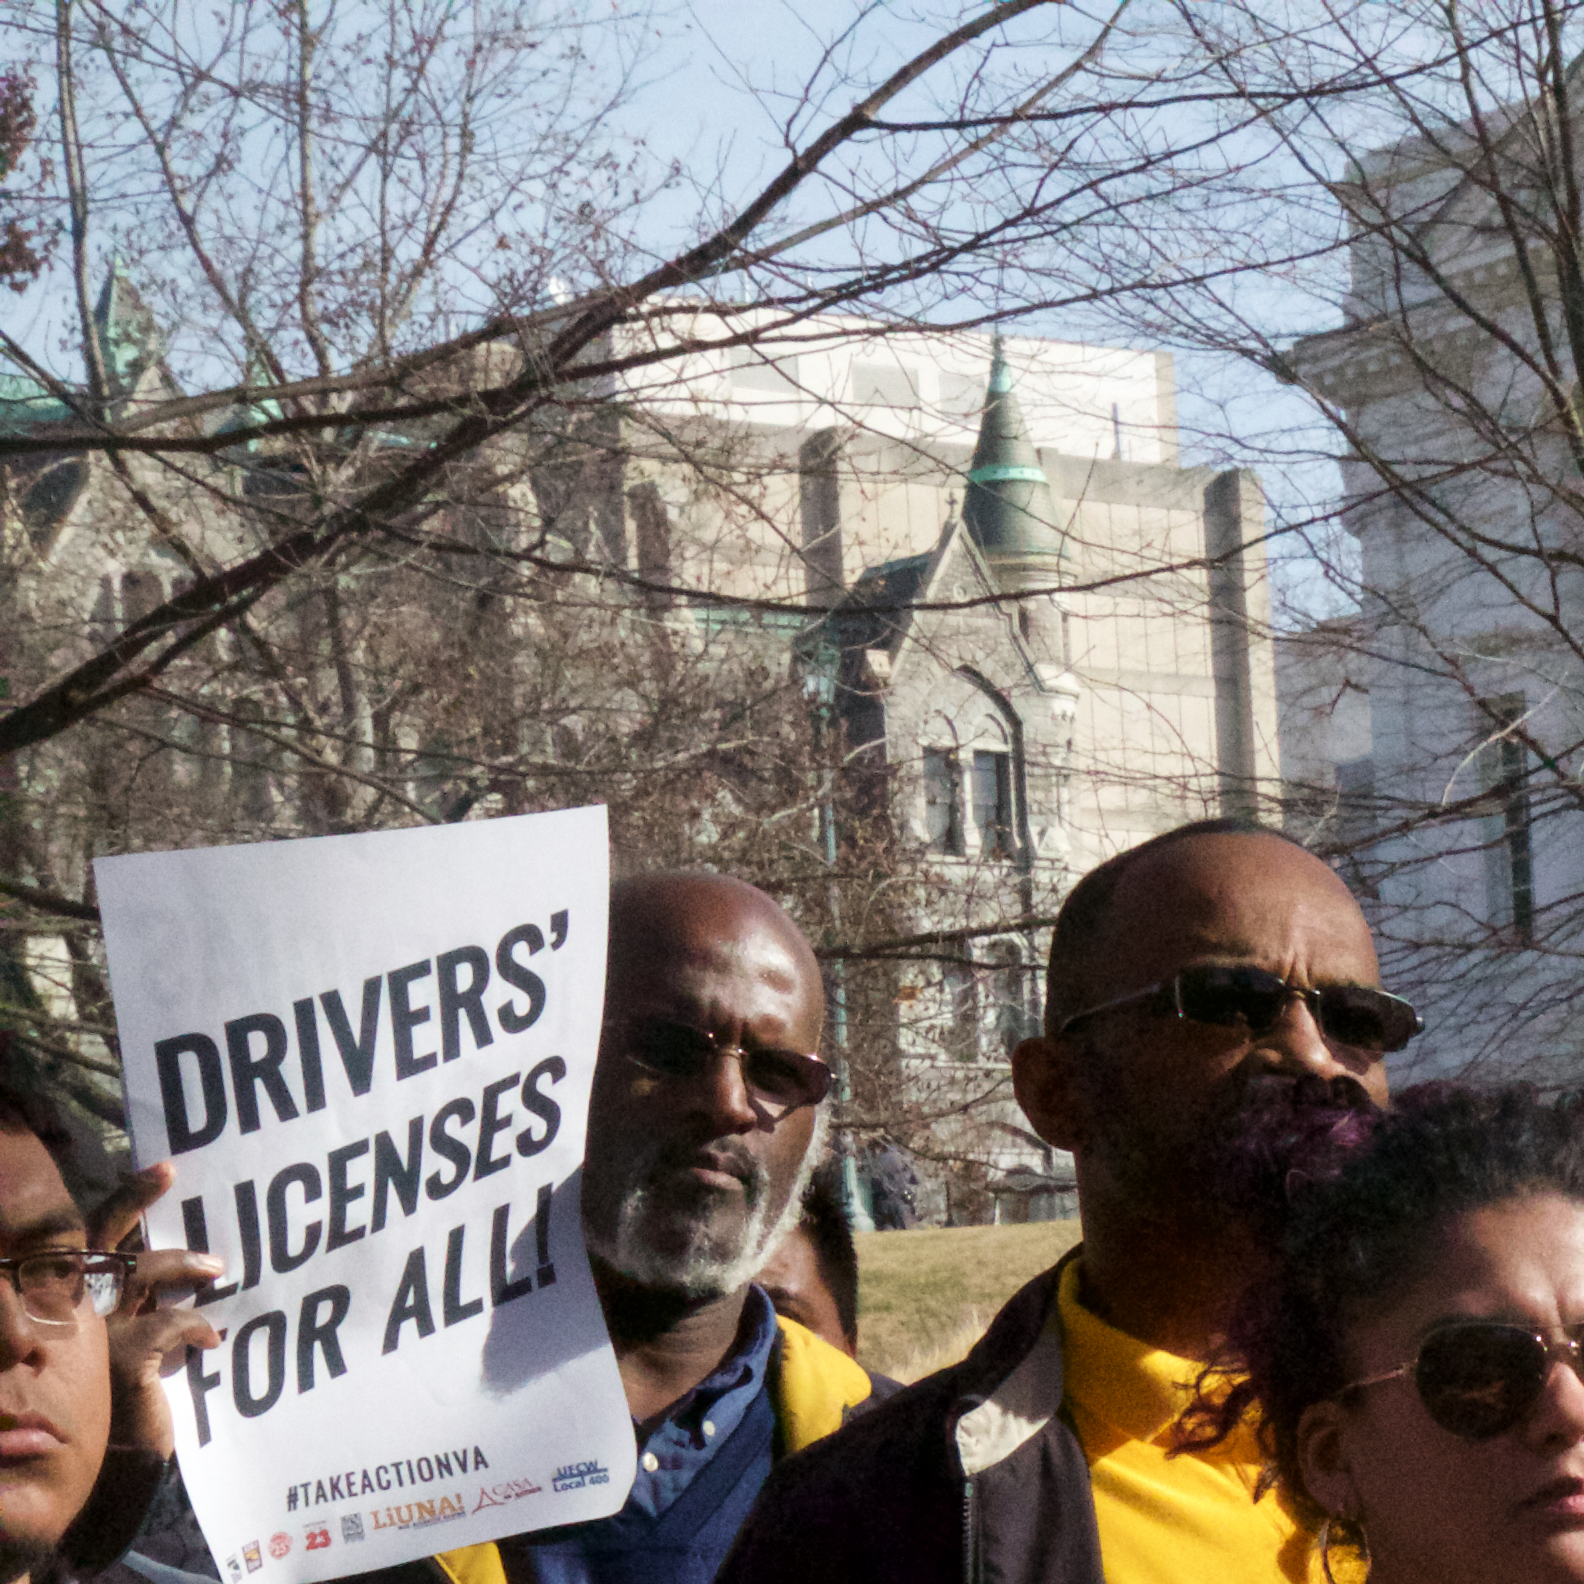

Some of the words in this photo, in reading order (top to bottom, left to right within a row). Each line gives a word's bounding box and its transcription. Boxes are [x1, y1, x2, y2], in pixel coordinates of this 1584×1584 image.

[154, 909, 570, 1156] DRIVERS'
[182, 1055, 567, 1306] LICENSES
[186, 1285, 352, 1449] FOR
[382, 1181, 558, 1356] ALL!
[287, 1446, 490, 1512] #TAKEACTIONVA
[553, 1475, 585, 1493] Local
[557, 1459, 598, 1478] UFCW
[371, 1494, 465, 1530] LiUNA!
[305, 1529, 331, 1551] 23
